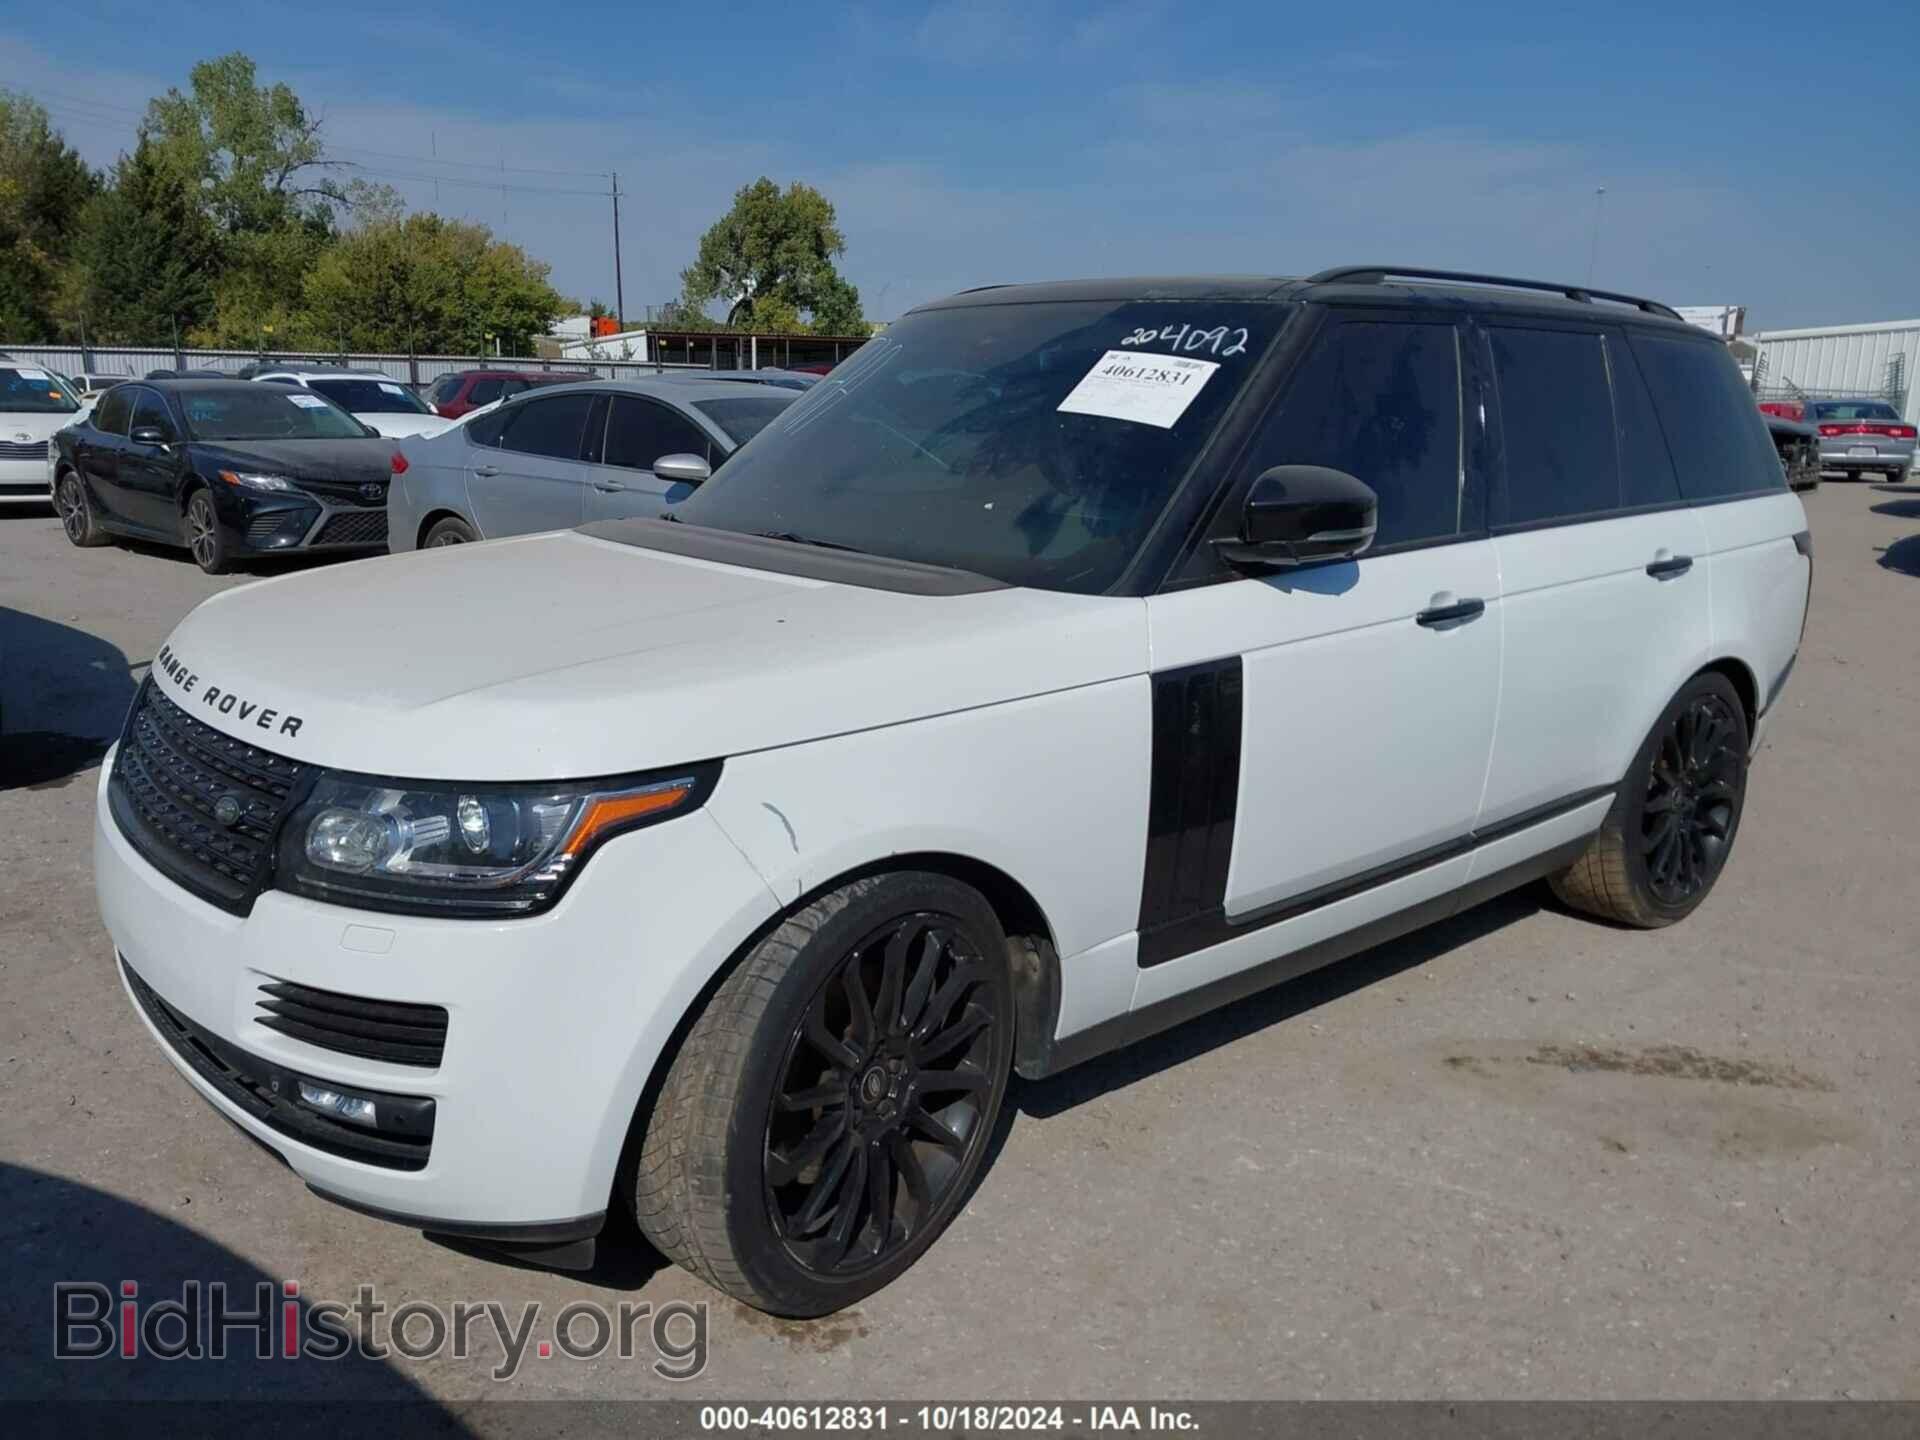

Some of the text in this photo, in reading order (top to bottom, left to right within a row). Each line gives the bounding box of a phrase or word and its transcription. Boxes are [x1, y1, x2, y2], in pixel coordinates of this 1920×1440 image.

[1120, 323, 1249, 356] 204092
[1102, 363, 1192, 386] 40612831
[158, 644, 303, 738] RANGE ROVER
